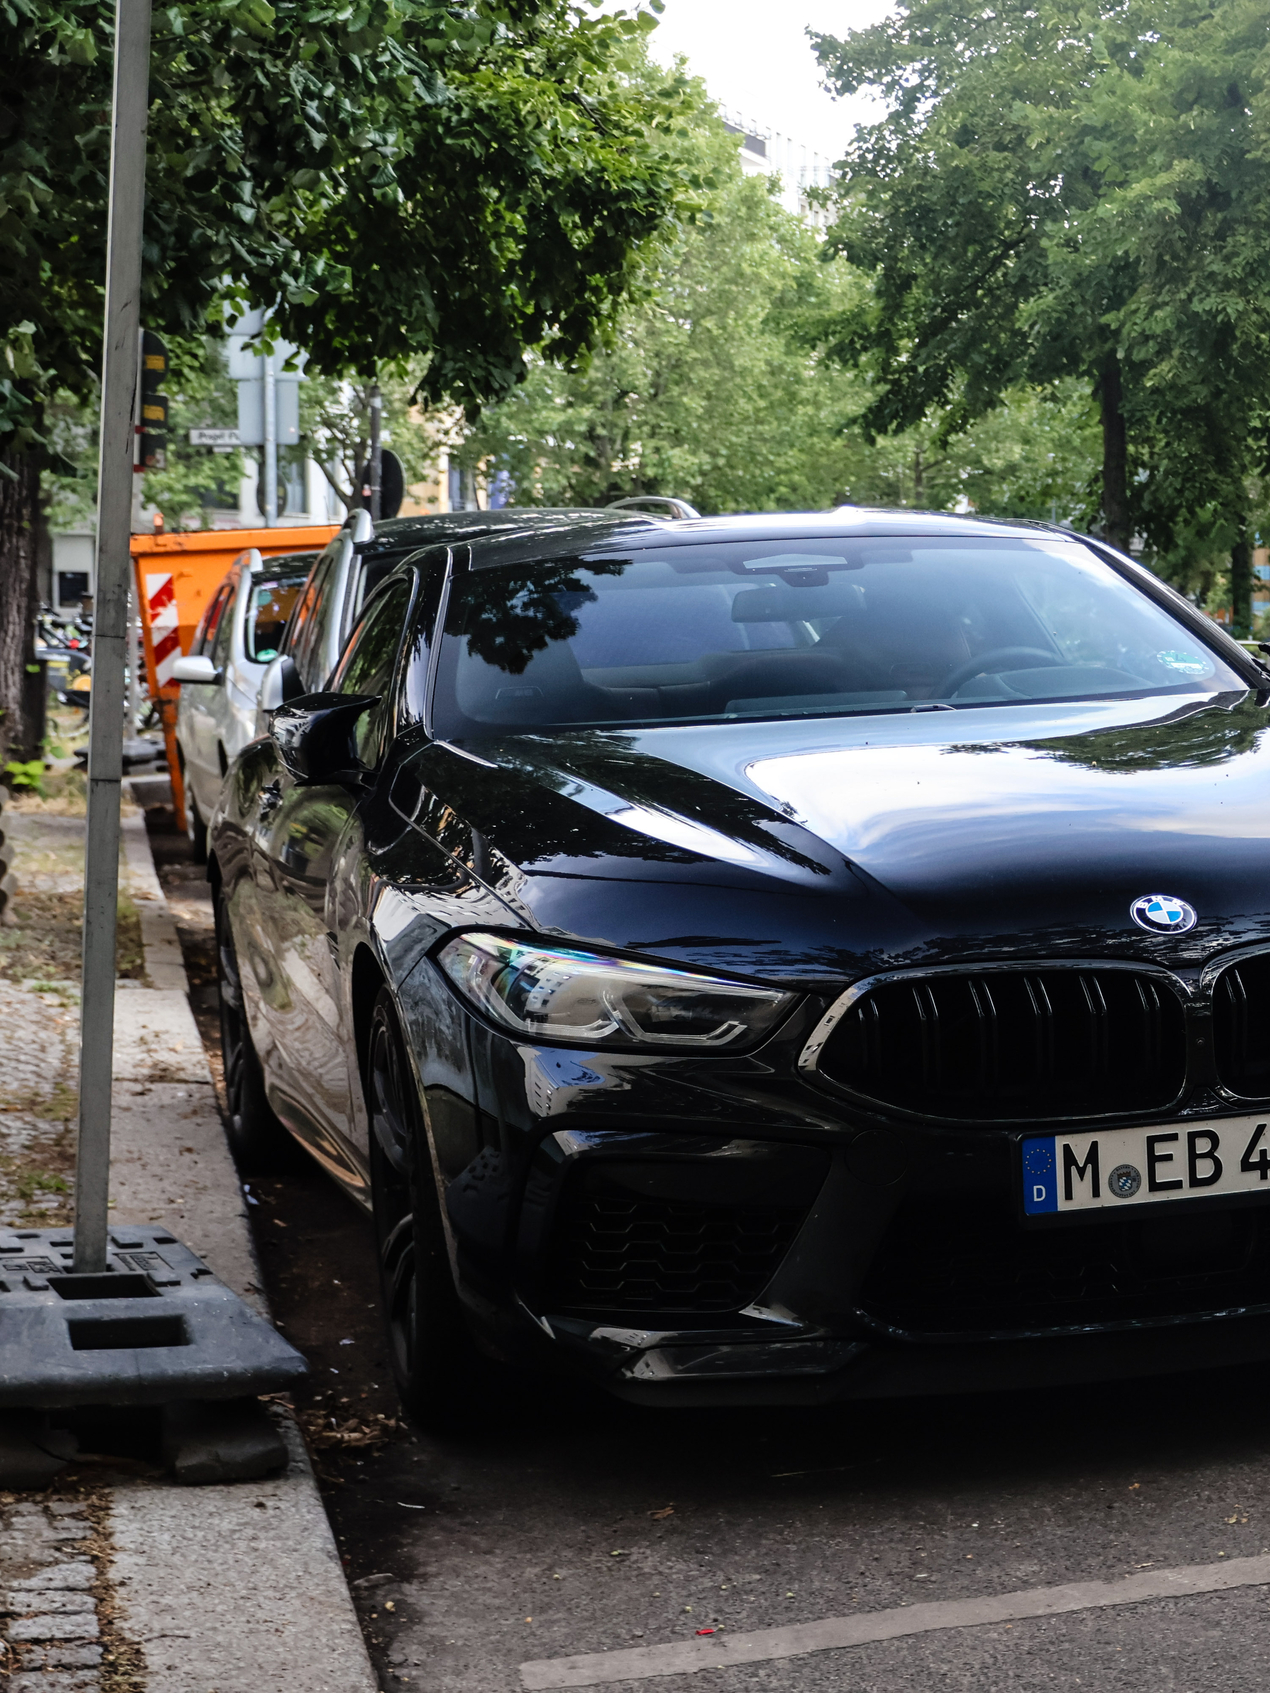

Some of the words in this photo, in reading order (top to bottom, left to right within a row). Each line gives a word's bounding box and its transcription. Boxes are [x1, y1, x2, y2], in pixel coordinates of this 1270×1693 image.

[1136, 896, 1184, 908] BMW
[1062, 1140, 1100, 1201] M
[1146, 1128, 1223, 1193] EB
[1033, 1185, 1046, 1202] D
